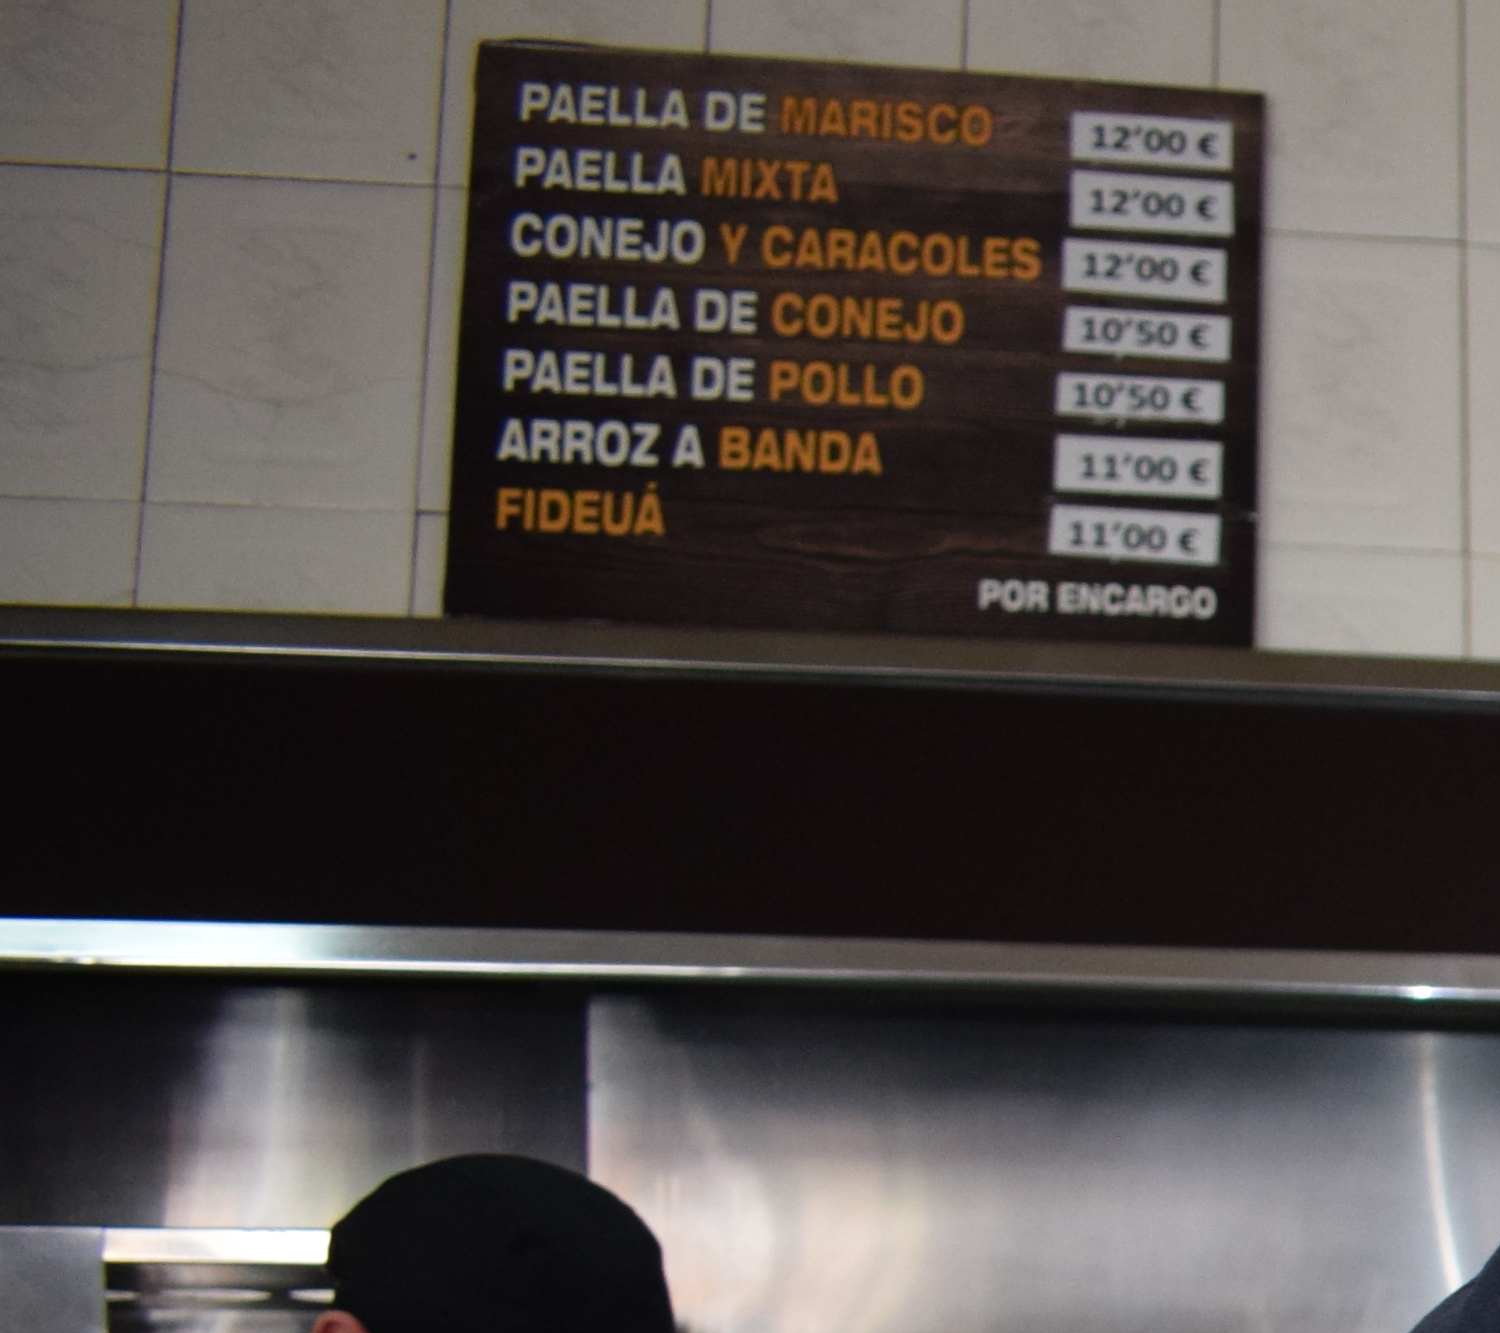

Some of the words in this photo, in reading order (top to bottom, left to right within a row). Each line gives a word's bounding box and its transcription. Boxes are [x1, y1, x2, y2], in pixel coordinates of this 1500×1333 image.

[521, 83, 689, 129] PAELLA
[705, 91, 766, 133] DE
[780, 97, 993, 146] MARISCO
[516, 146, 685, 194] PAELLA
[701, 158, 838, 202] MIXTA
[511, 213, 705, 264] CONEJO
[721, 224, 746, 264] Y
[762, 227, 1041, 281] CARACOLES
[507, 281, 679, 330] PAELLA
[694, 289, 758, 333] DE
[771, 293, 964, 343] CONEJO
[502, 349, 676, 397] PAELLA
[691, 356, 756, 401] DE
[769, 361, 924, 409] POLLO
[497, 418, 660, 465] ARROZ
[672, 425, 705, 467] A
[719, 427, 882, 475] BANDA
[496, 482, 665, 535] FIDEUÁ
[978, 578, 1049, 612] POR
[1056, 581, 1218, 620] ENCARGO
